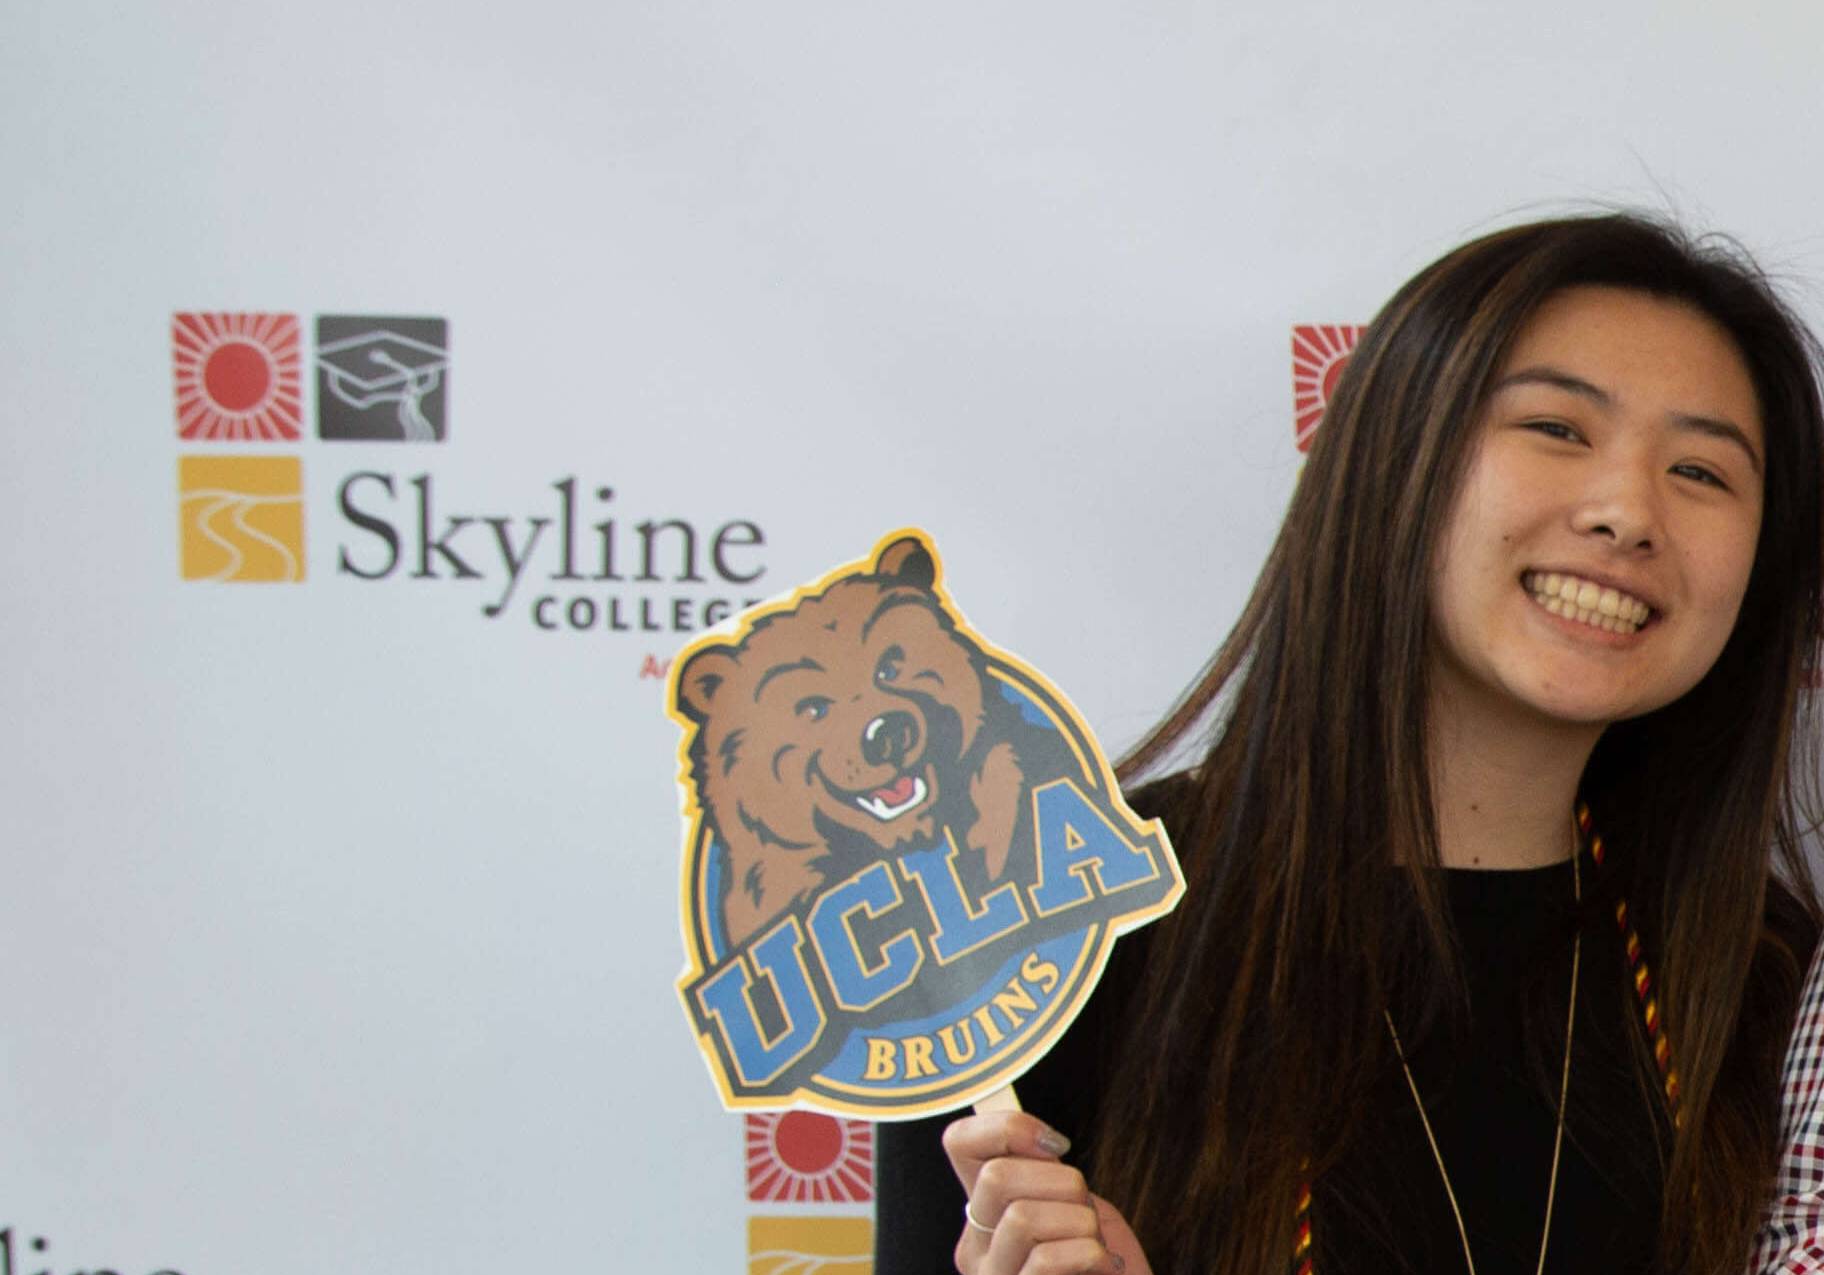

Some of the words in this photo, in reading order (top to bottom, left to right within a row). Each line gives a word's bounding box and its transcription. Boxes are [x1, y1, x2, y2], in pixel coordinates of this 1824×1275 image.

[337, 471, 766, 616] Skyline
[533, 596, 760, 632] COLLEG
[697, 777, 1161, 1087] UCLA
[864, 952, 1060, 1082] BRUINS
